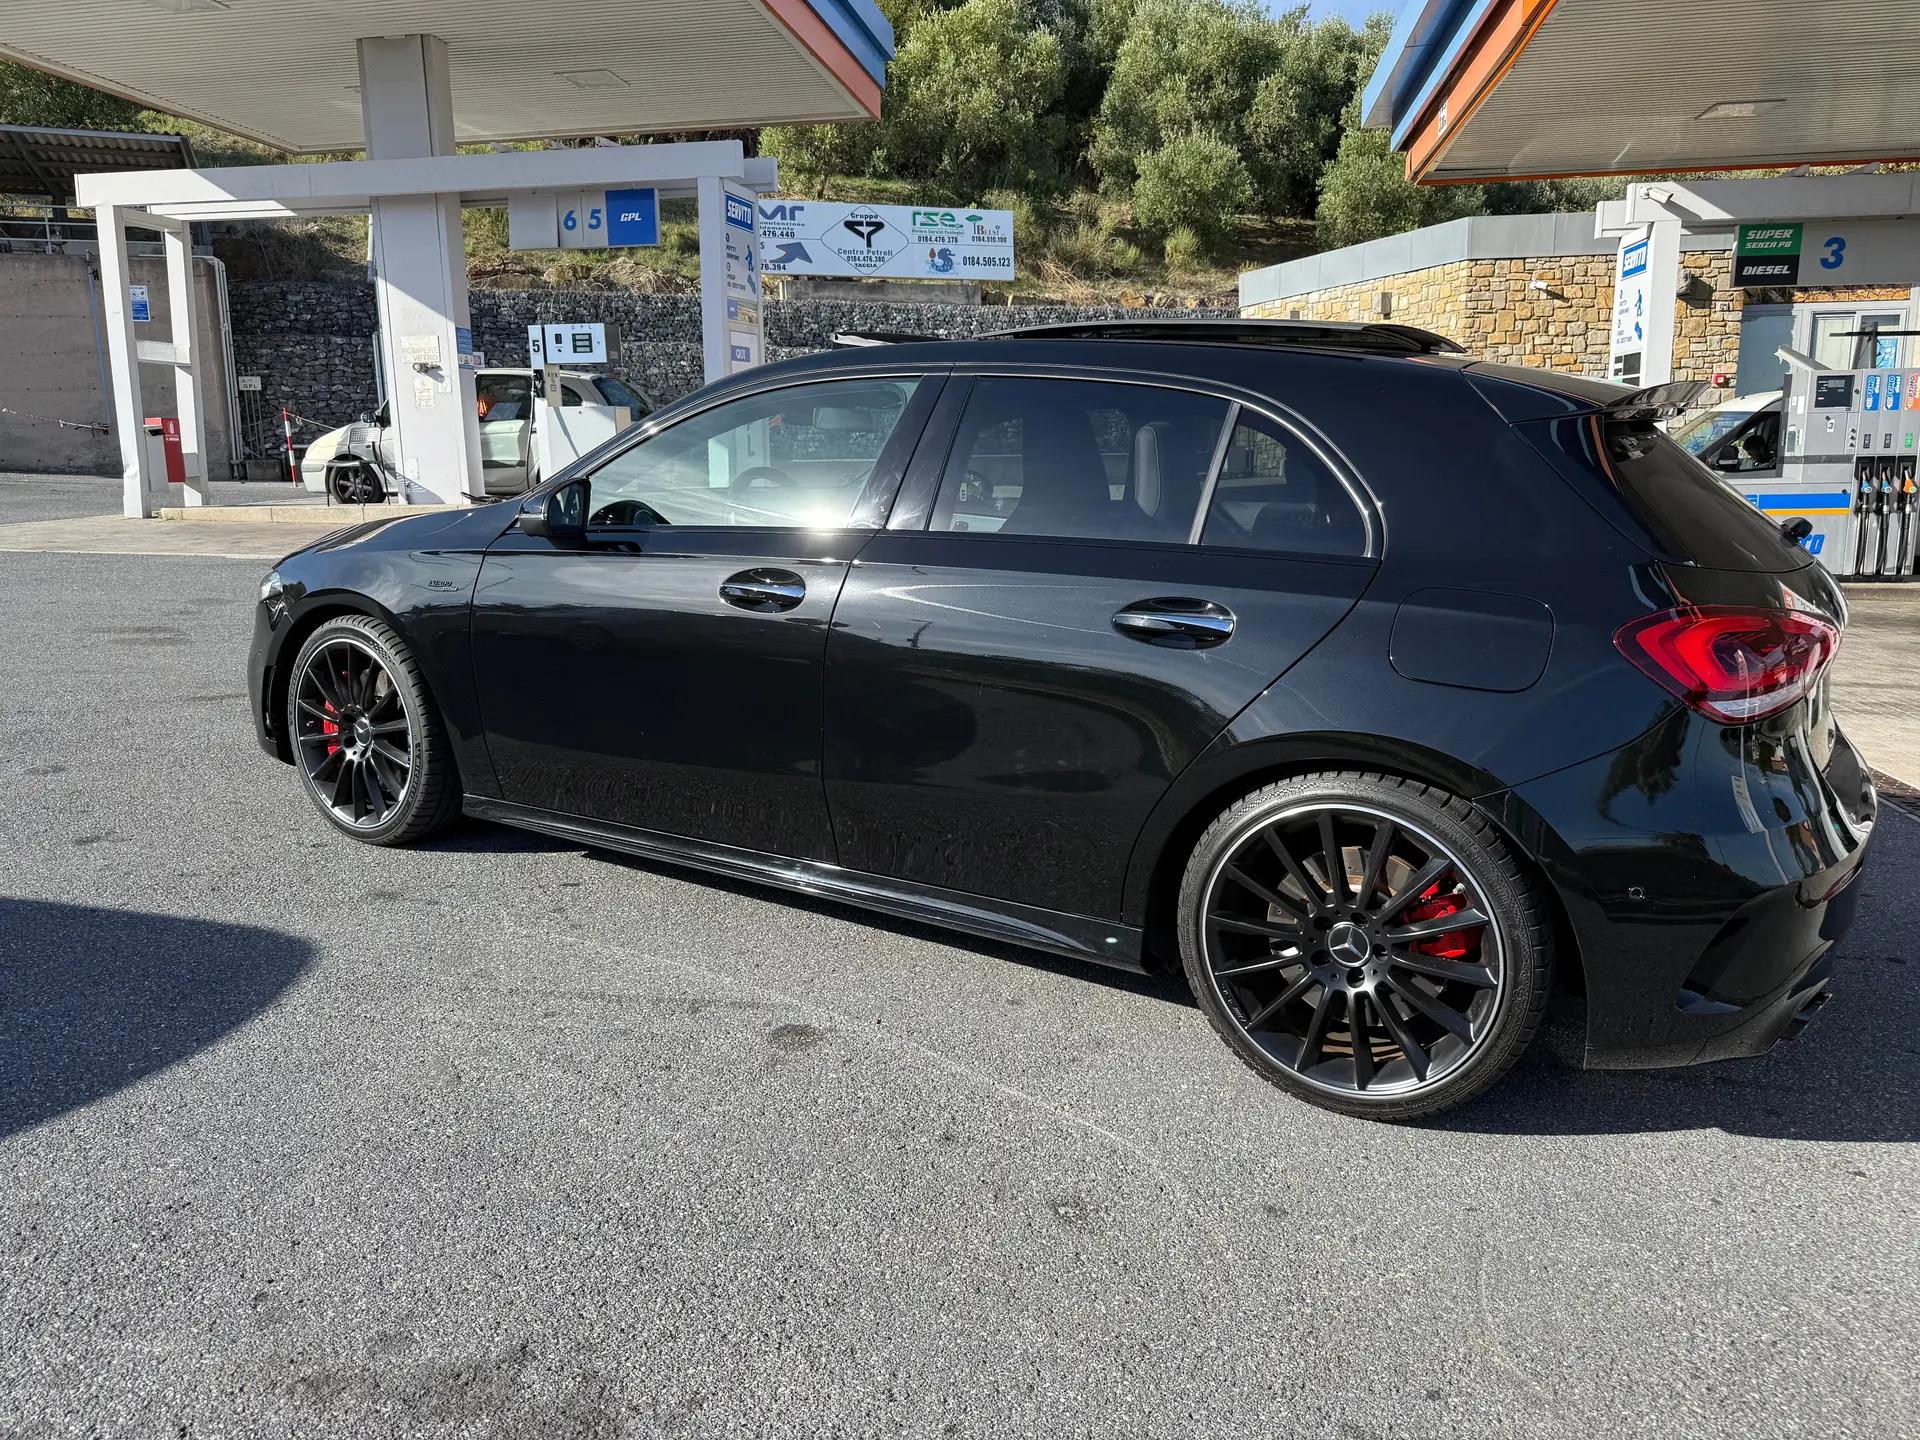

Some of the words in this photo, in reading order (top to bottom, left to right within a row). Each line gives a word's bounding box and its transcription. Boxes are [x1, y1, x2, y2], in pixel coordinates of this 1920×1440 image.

[727, 200, 752, 224] SERVITO
[563, 210, 577, 230] 6
[588, 209, 602, 230] 5
[620, 213, 641, 222] GPL
[760, 230, 795, 238] .476.440
[1746, 229, 1793, 239] SUPER
[1745, 241, 1776, 249] SENZA
[837, 248, 864, 256] Centro
[1820, 236, 1846, 270] 3
[963, 256, 1010, 267] 0184.505.123
[761, 263, 786, 271] 76.394
[1742, 265, 1791, 275] DIESEL
[532, 340, 540, 353] 5
[1828, 422, 1834, 430] 3
